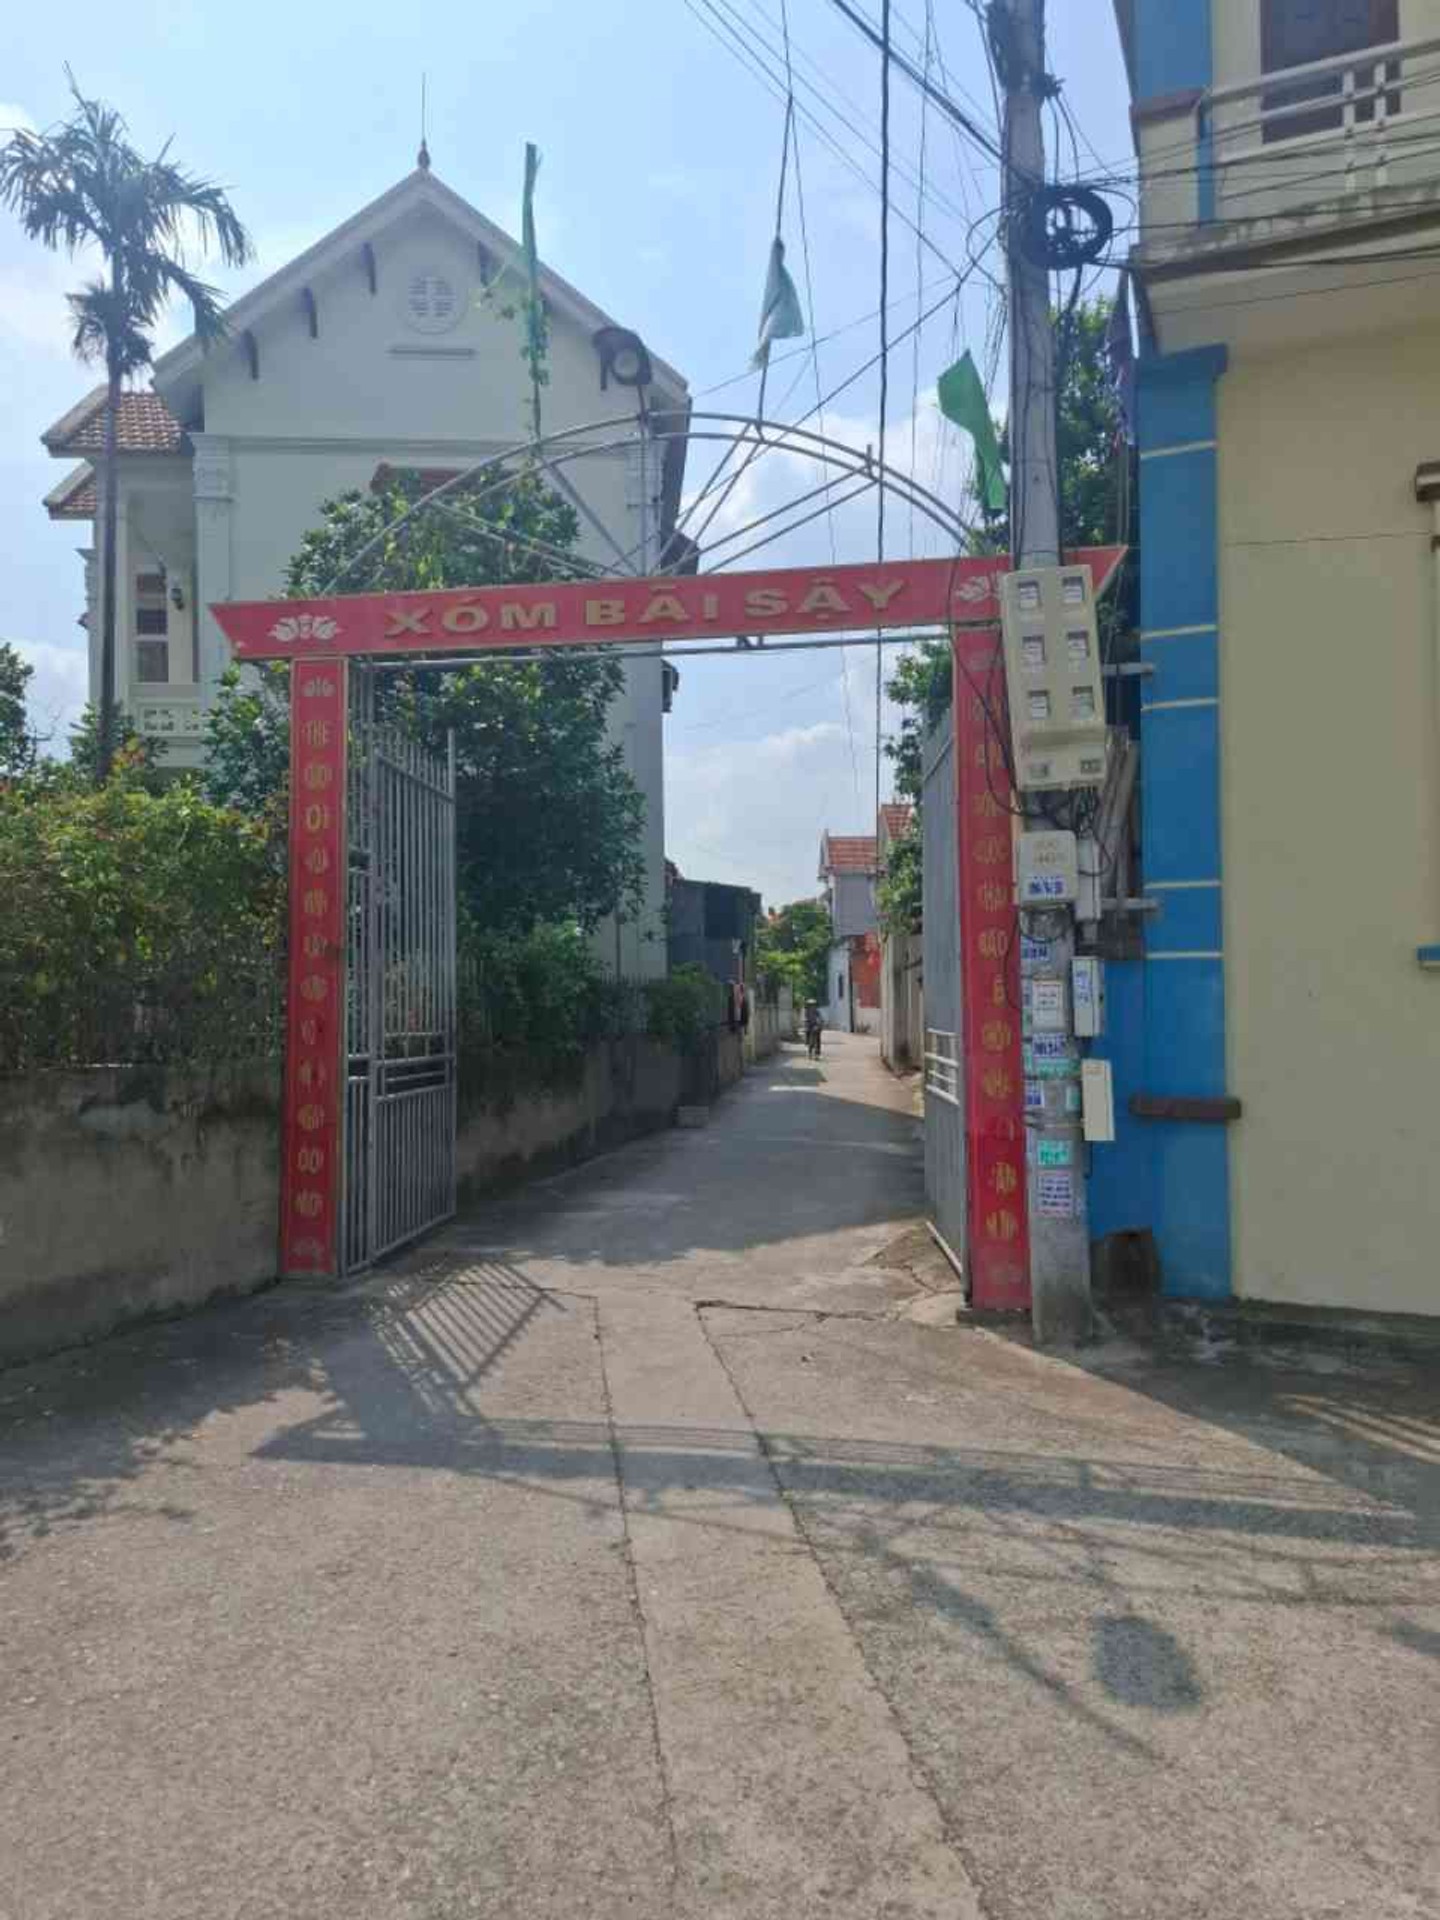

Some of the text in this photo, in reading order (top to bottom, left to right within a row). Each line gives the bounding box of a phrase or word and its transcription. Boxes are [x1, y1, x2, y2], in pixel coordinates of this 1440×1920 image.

[384, 576, 905, 639] XÓM BÃI SẬY
